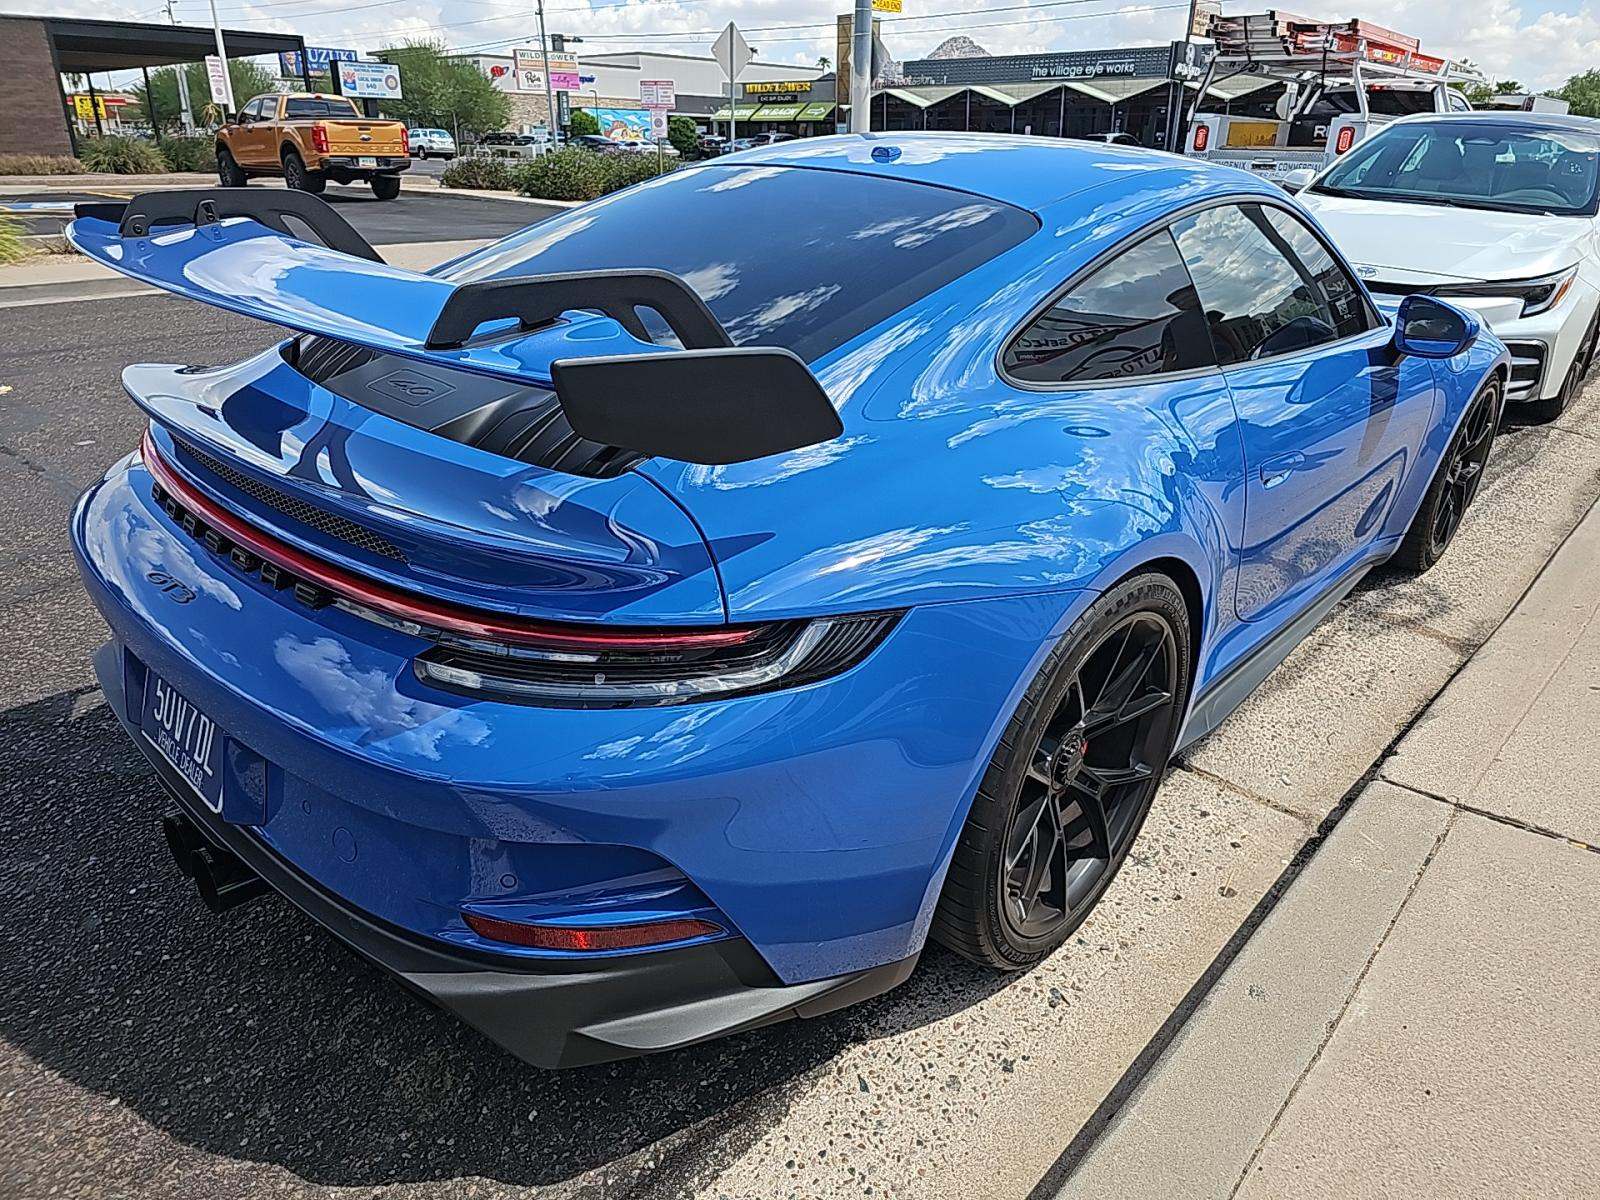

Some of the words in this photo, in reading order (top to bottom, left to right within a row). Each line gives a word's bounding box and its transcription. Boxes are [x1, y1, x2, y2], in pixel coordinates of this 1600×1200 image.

[876, 0, 890, 8] DEAD
[891, 0, 901, 10] END
[1031, 65, 1048, 77] the
[1049, 65, 1083, 77] village
[1085, 63, 1104, 78] eye
[1106, 62, 1135, 74] works
[745, 81, 811, 93] WILDFLOWER
[331, 145, 402, 153] RANGER
[151, 481, 319, 606] PORSCHE
[146, 569, 198, 606] GT3
[153, 678, 216, 777] 5UV7DL
[179, 751, 204, 791] DEALER
